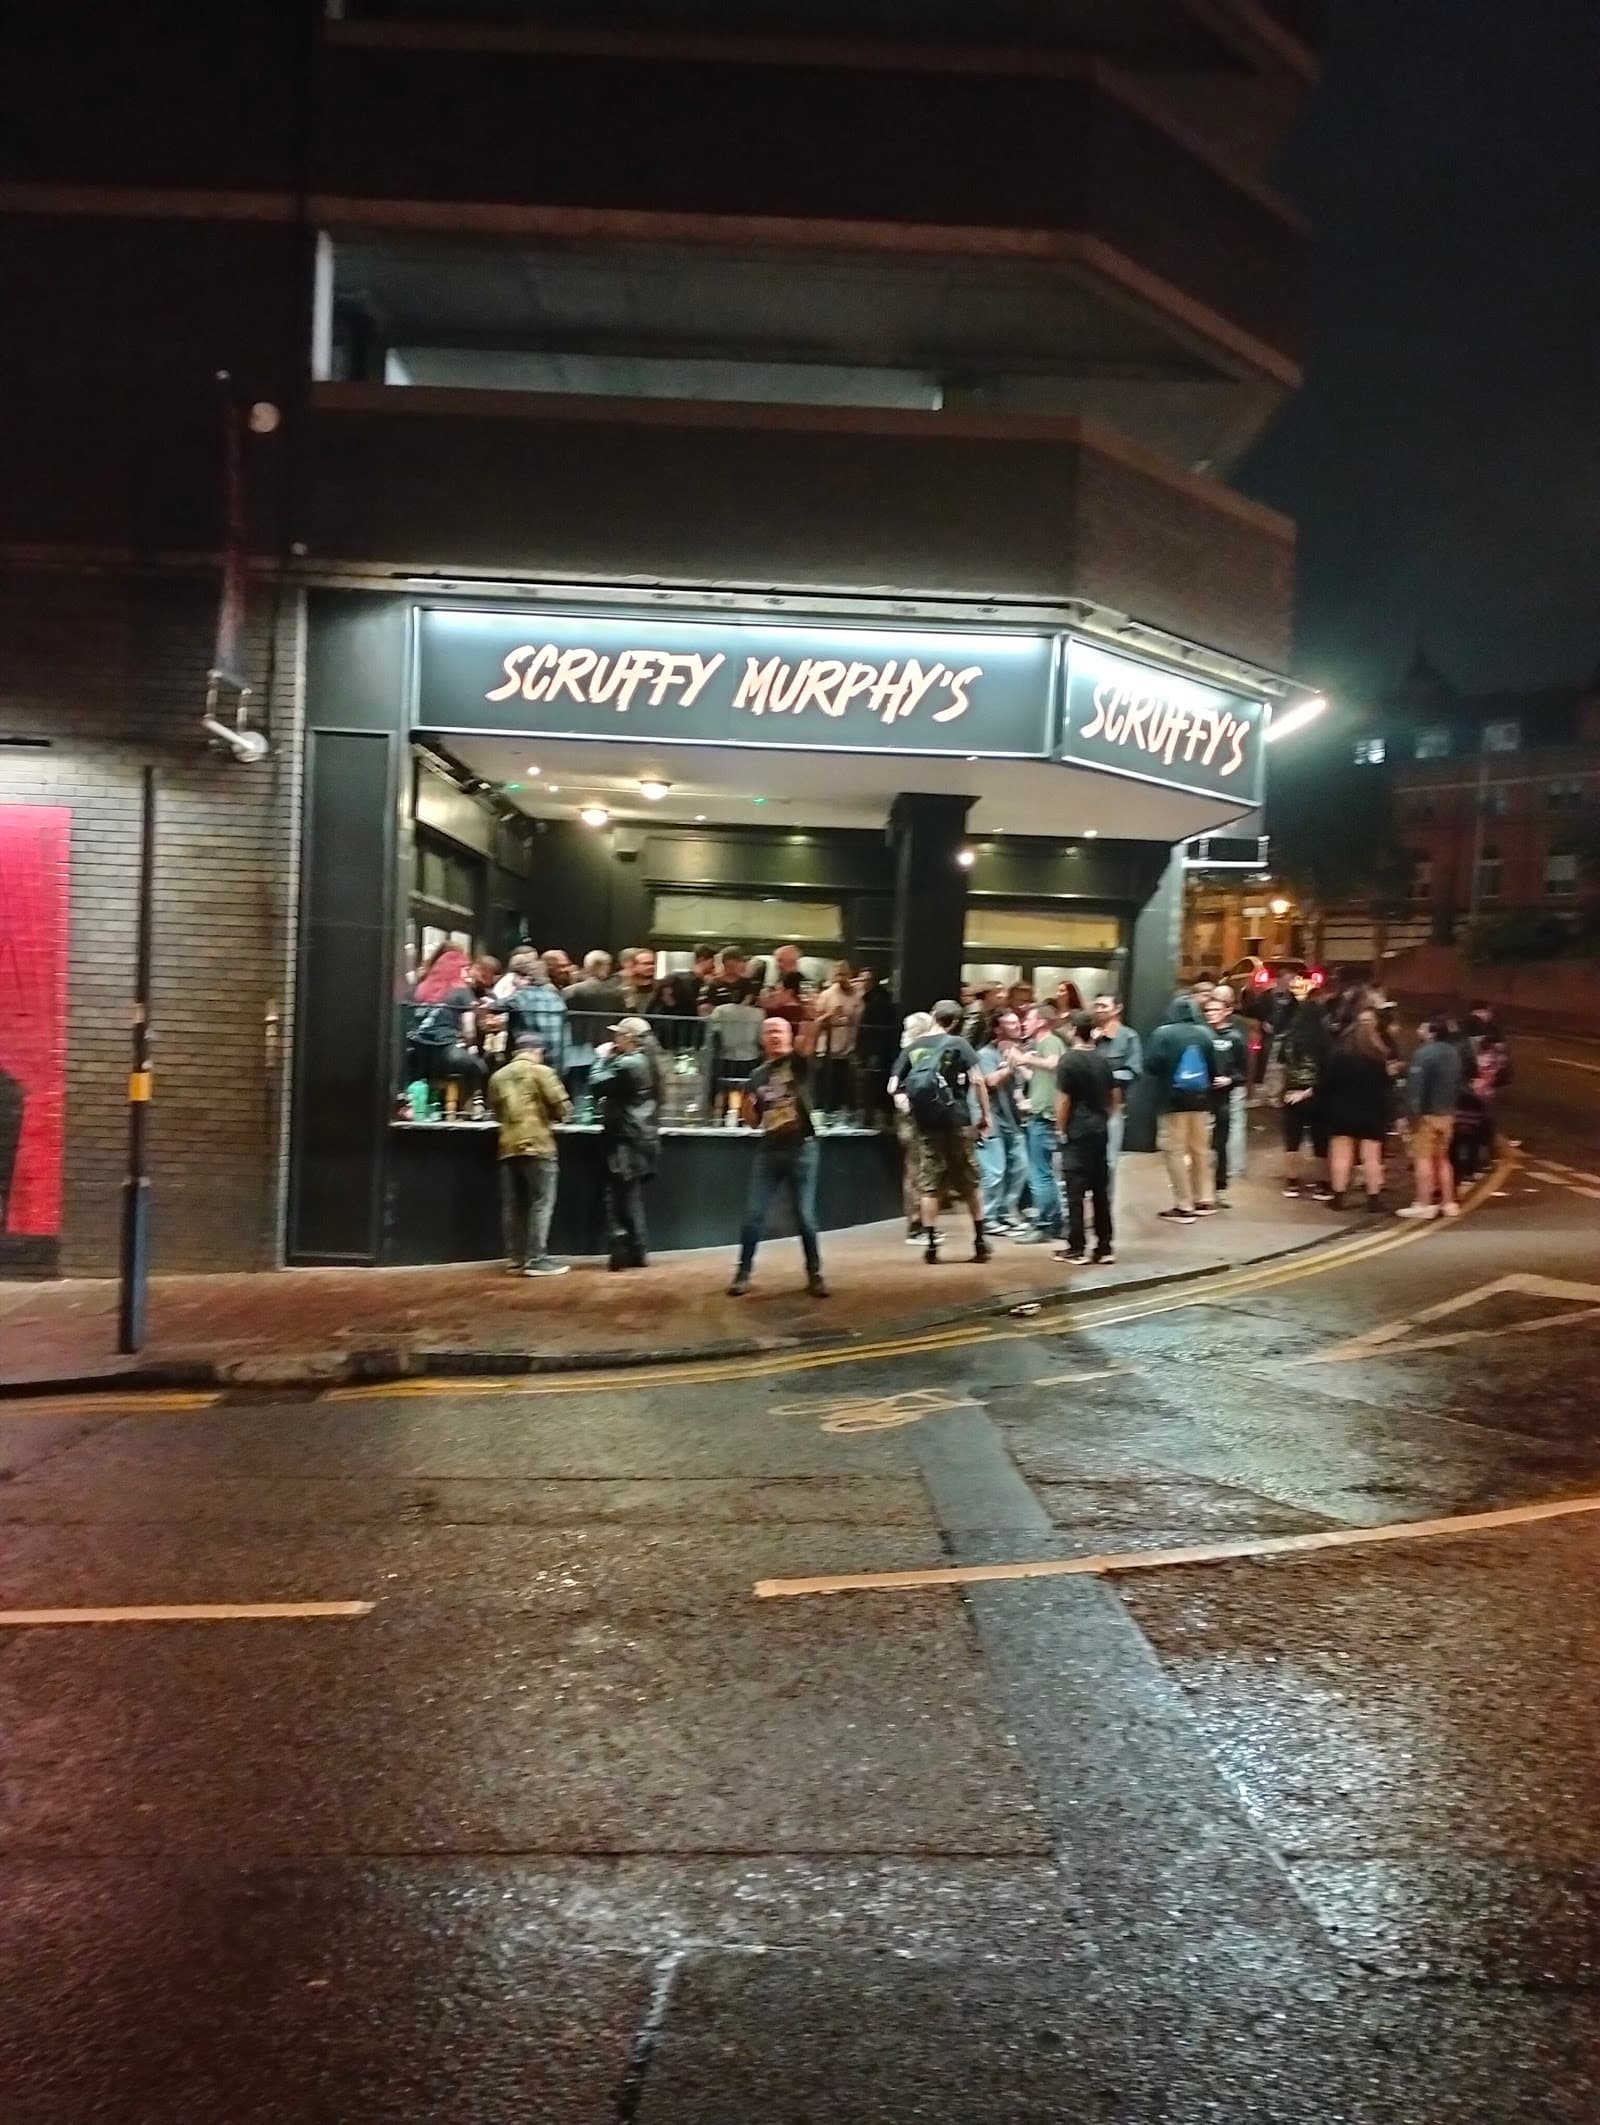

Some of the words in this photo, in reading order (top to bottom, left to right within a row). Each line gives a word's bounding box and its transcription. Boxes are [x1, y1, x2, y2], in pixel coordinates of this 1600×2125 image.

[485, 644, 725, 711] SCRUFFY
[733, 656, 983, 724] MURPHY'S
[1080, 682, 1250, 776] SCRUFFY'S
